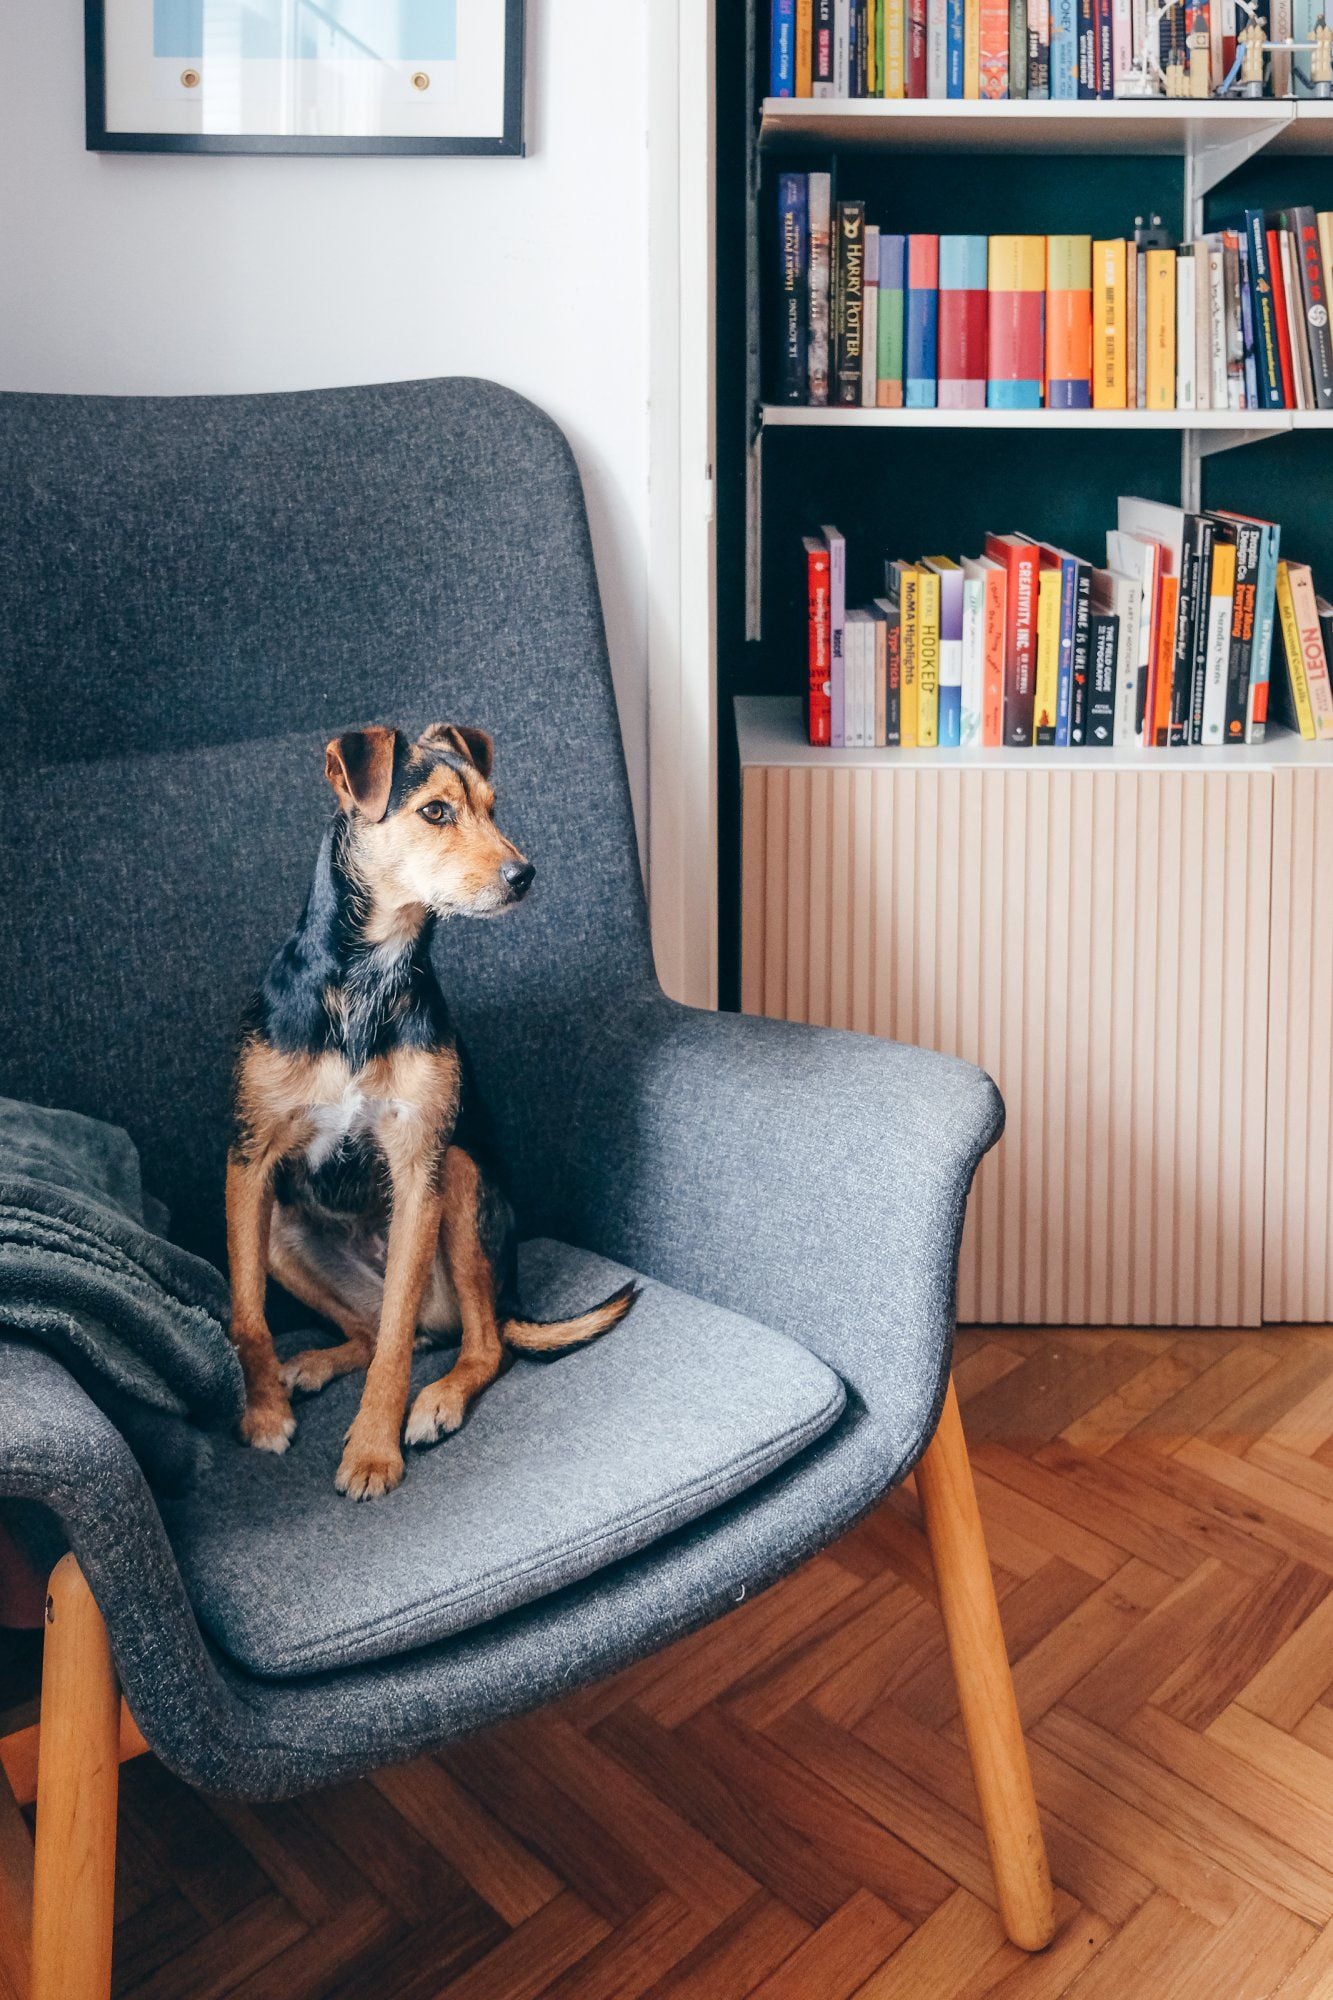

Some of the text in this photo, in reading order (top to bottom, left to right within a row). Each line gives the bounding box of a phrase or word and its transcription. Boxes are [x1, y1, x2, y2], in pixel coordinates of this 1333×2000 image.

[1061, 0, 1071, 33] ONEY
[784, 212, 794, 253] POTTER
[784, 254, 794, 291] HARRY
[1301, 225, 1322, 301] MAUS
[845, 244, 862, 358] HARRY POTTER
[1235, 530, 1250, 581] Design Co.
[1247, 530, 1260, 569] Draplin
[1015, 561, 1033, 651] CREATIVITY, INC.
[1079, 576, 1090, 595] MY
[902, 581, 916, 685] MoMA Highlights
[1077, 598, 1089, 629] NAME
[1126, 623, 1133, 633] OF
[1230, 584, 1245, 638] Everything
[1241, 584, 1256, 641] Pretty Much
[1262, 619, 1272, 630] In
[888, 626, 900, 654] Type
[921, 624, 936, 692] HOOKED
[1074, 647, 1087, 671] GIRL
[1102, 625, 1115, 692] THE FIELD GUIDE
[1212, 611, 1227, 685] Sunday Suns
[1258, 631, 1271, 675] Progress
[1286, 622, 1298, 657] Second
[1302, 627, 1326, 681] LEON
[889, 655, 900, 689] Tricks
[1094, 635, 1106, 693] TYPOGRAPHY
[1291, 659, 1306, 704] Cocktails
